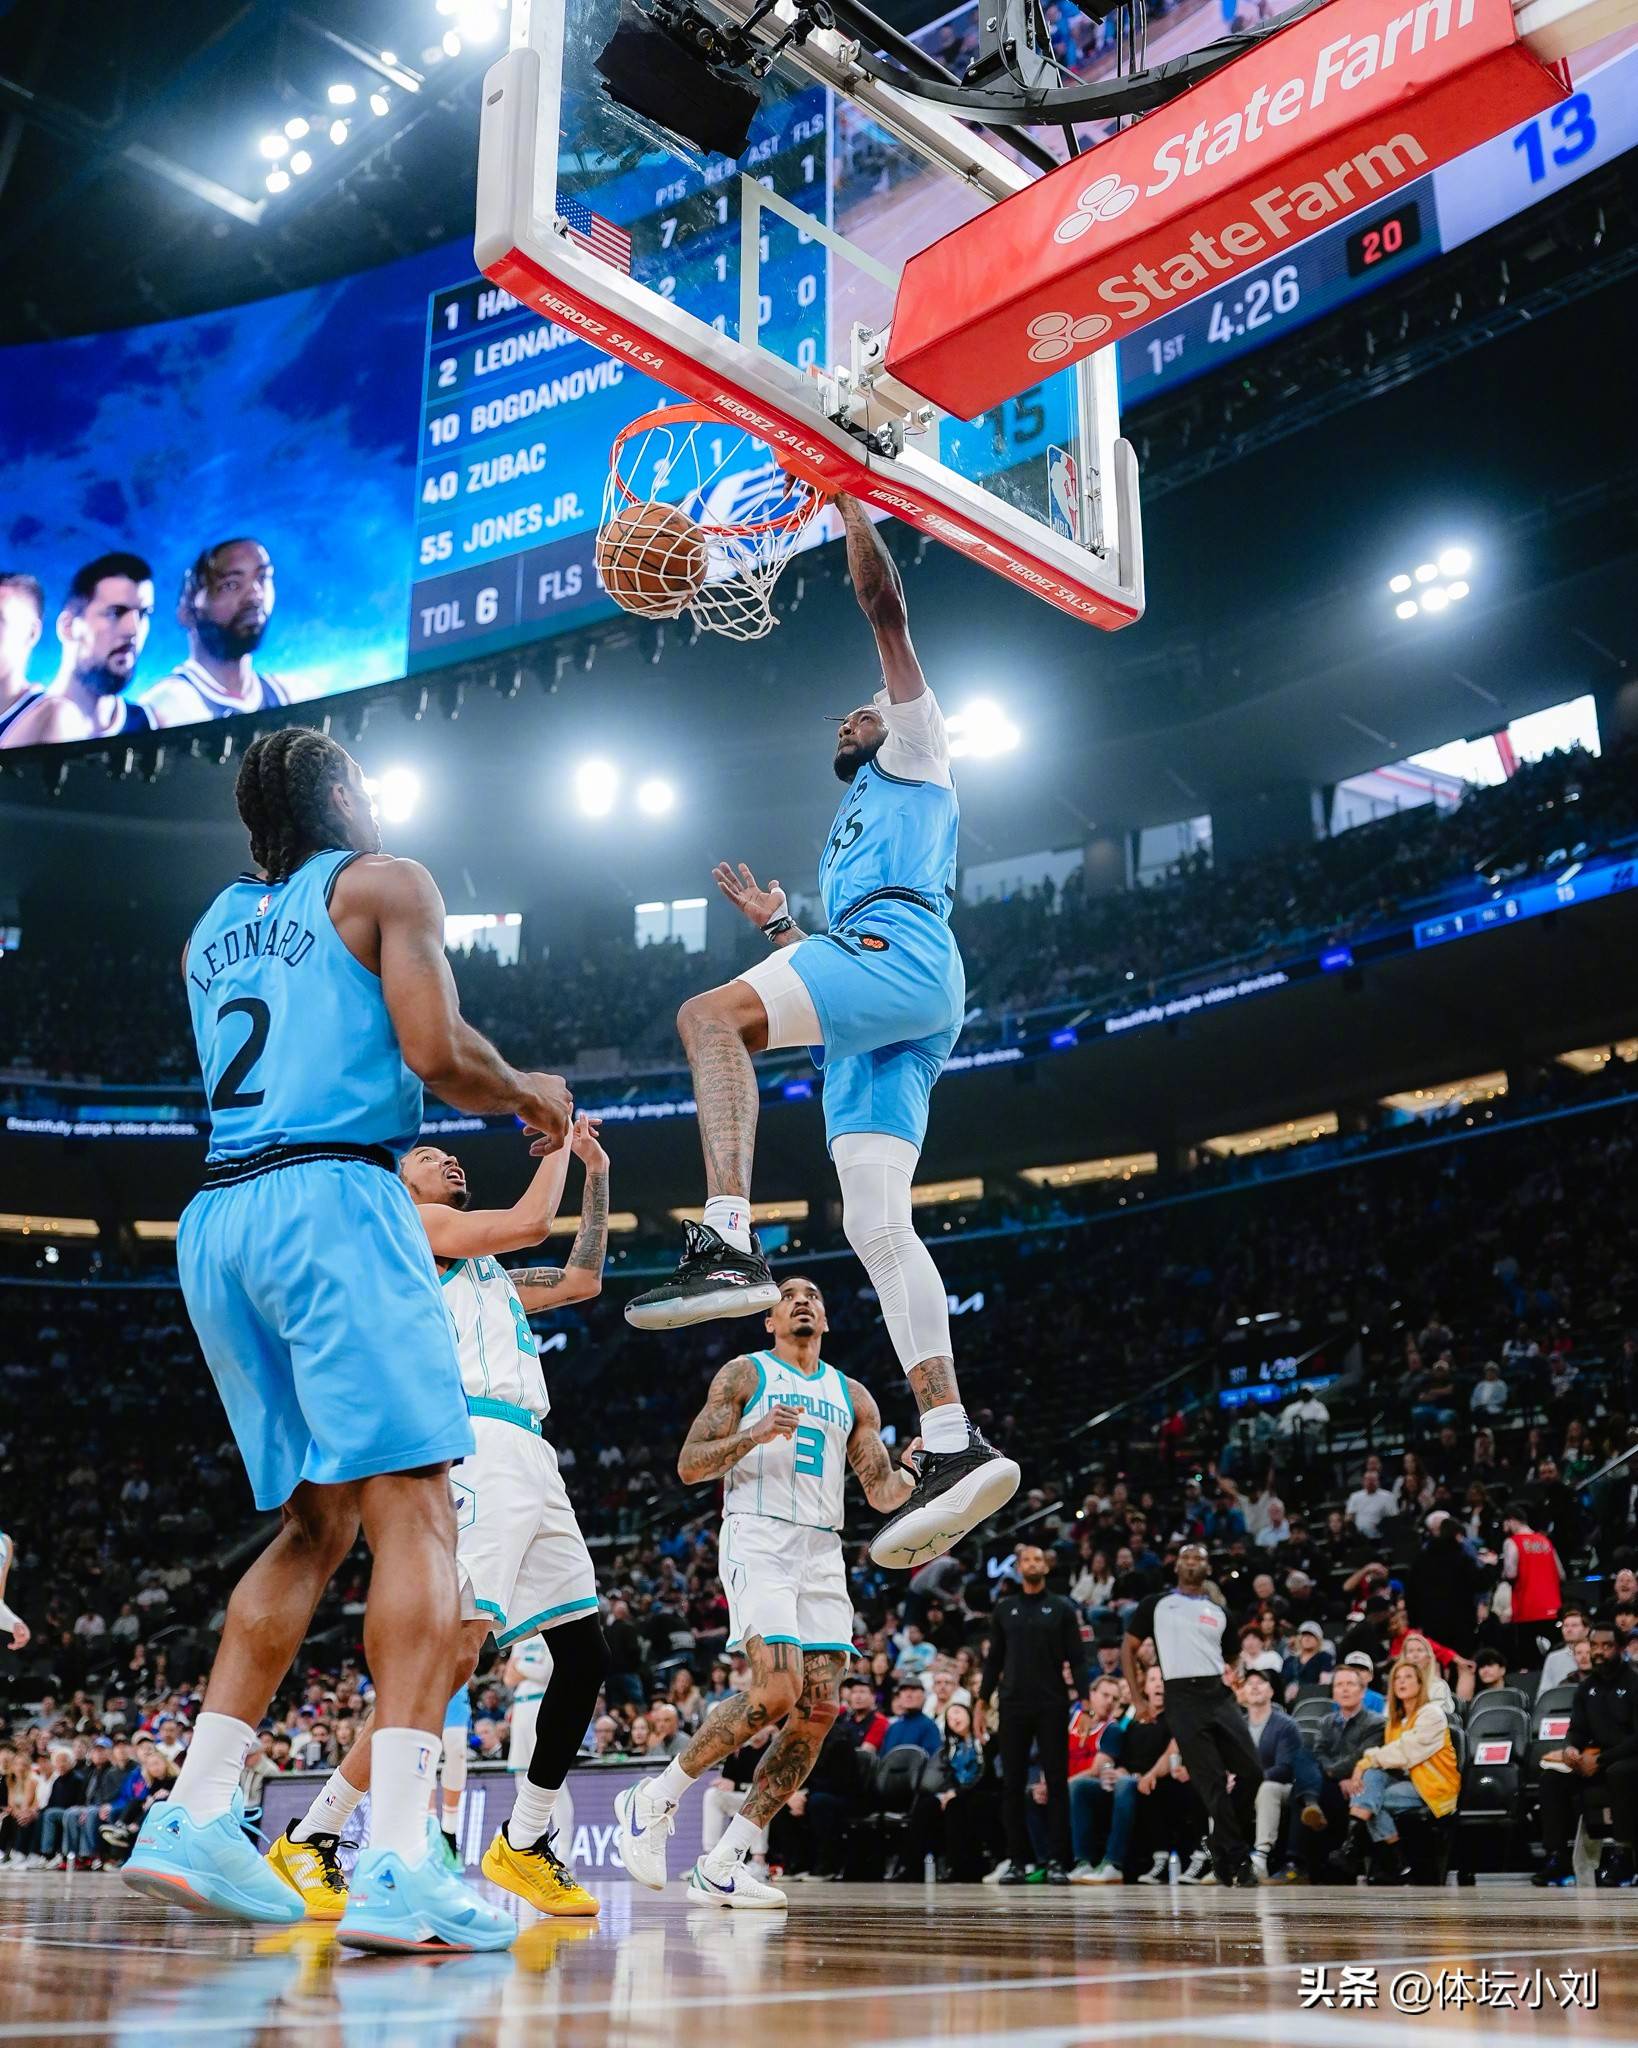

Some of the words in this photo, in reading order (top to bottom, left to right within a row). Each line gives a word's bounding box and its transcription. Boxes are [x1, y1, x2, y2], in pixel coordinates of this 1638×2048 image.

[791, 113, 824, 143] FLS
[1513, 92, 1597, 184] 13
[660, 217, 678, 249] 7
[715, 195, 728, 224] 1
[801, 154, 814, 183] 1
[714, 253, 727, 282] 1
[1361, 219, 1403, 265] 20
[444, 302, 459, 330] 1
[797, 274, 817, 307] 0
[1147, 333, 1186, 375] 1ST
[1207, 264, 1301, 344] 4:26
[538, 293, 608, 336] HERDEZ
[607, 333, 665, 371] SALSA
[797, 337, 816, 371] 0
[429, 413, 460, 447] 10
[471, 358, 624, 434] BOGDANOVIC
[437, 357, 458, 388] 2
[710, 437, 723, 467] 1
[713, 394, 776, 432] HERDEZ
[773, 430, 826, 465] SALSA
[421, 470, 458, 505] 40
[466, 442, 547, 493] ZUBAC
[867, 489, 924, 516] HERDEZ
[419, 530, 454, 565] 55
[462, 503, 542, 553] JONES
[545, 492, 584, 527] JR.
[420, 600, 465, 638] TOL
[475, 587, 499, 625] 6
[538, 564, 582, 604] FLS
[1006, 557, 1057, 591] HERDEZ
[1055, 584, 1098, 615] SALSA
[190, 918, 316, 997] LEONARD
[210, 996, 272, 1112] 2
[794, 1424, 826, 1478] 3
